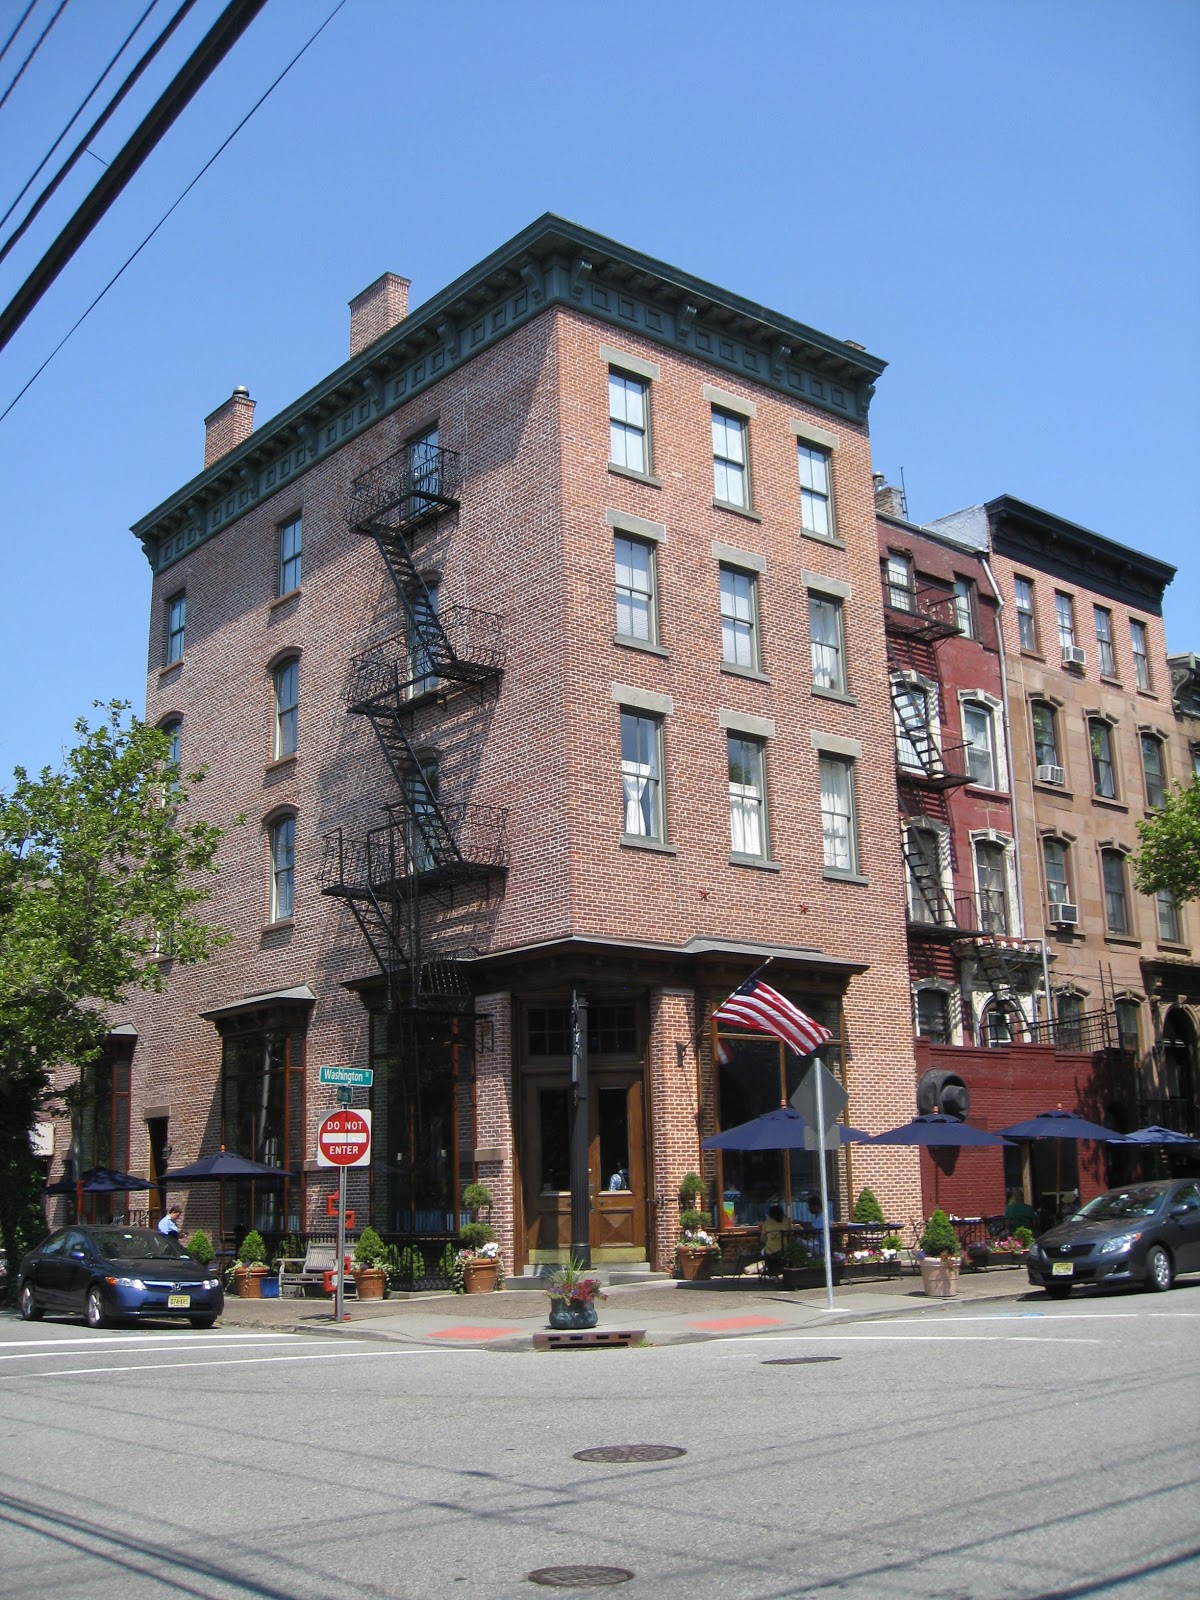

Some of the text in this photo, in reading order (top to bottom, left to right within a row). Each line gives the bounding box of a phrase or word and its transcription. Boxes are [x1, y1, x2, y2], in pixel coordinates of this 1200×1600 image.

[324, 1068, 363, 1083] Washington
[327, 1121, 363, 1130] DO NOT
[330, 1145, 359, 1155] ENTER
